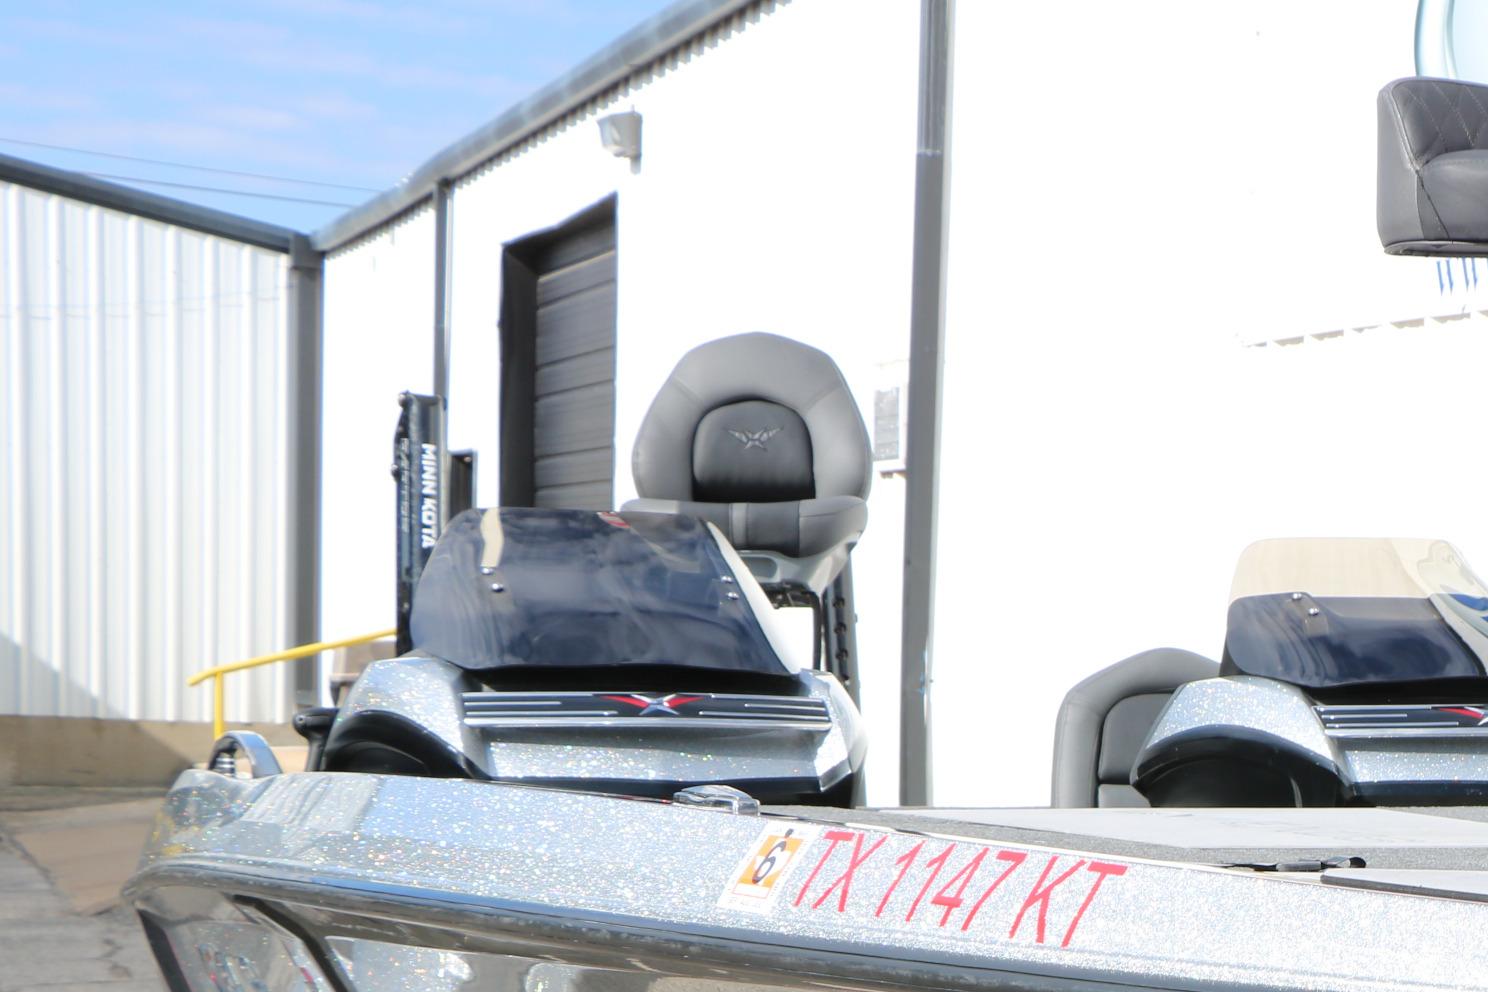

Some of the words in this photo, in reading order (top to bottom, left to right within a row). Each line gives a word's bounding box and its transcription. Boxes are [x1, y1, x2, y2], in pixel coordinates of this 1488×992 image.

[421, 443, 438, 495] MINN
[421, 497, 438, 549] KOTA
[793, 830, 888, 913] TX
[874, 840, 1028, 932] 1147
[1008, 855, 1129, 948] KT
